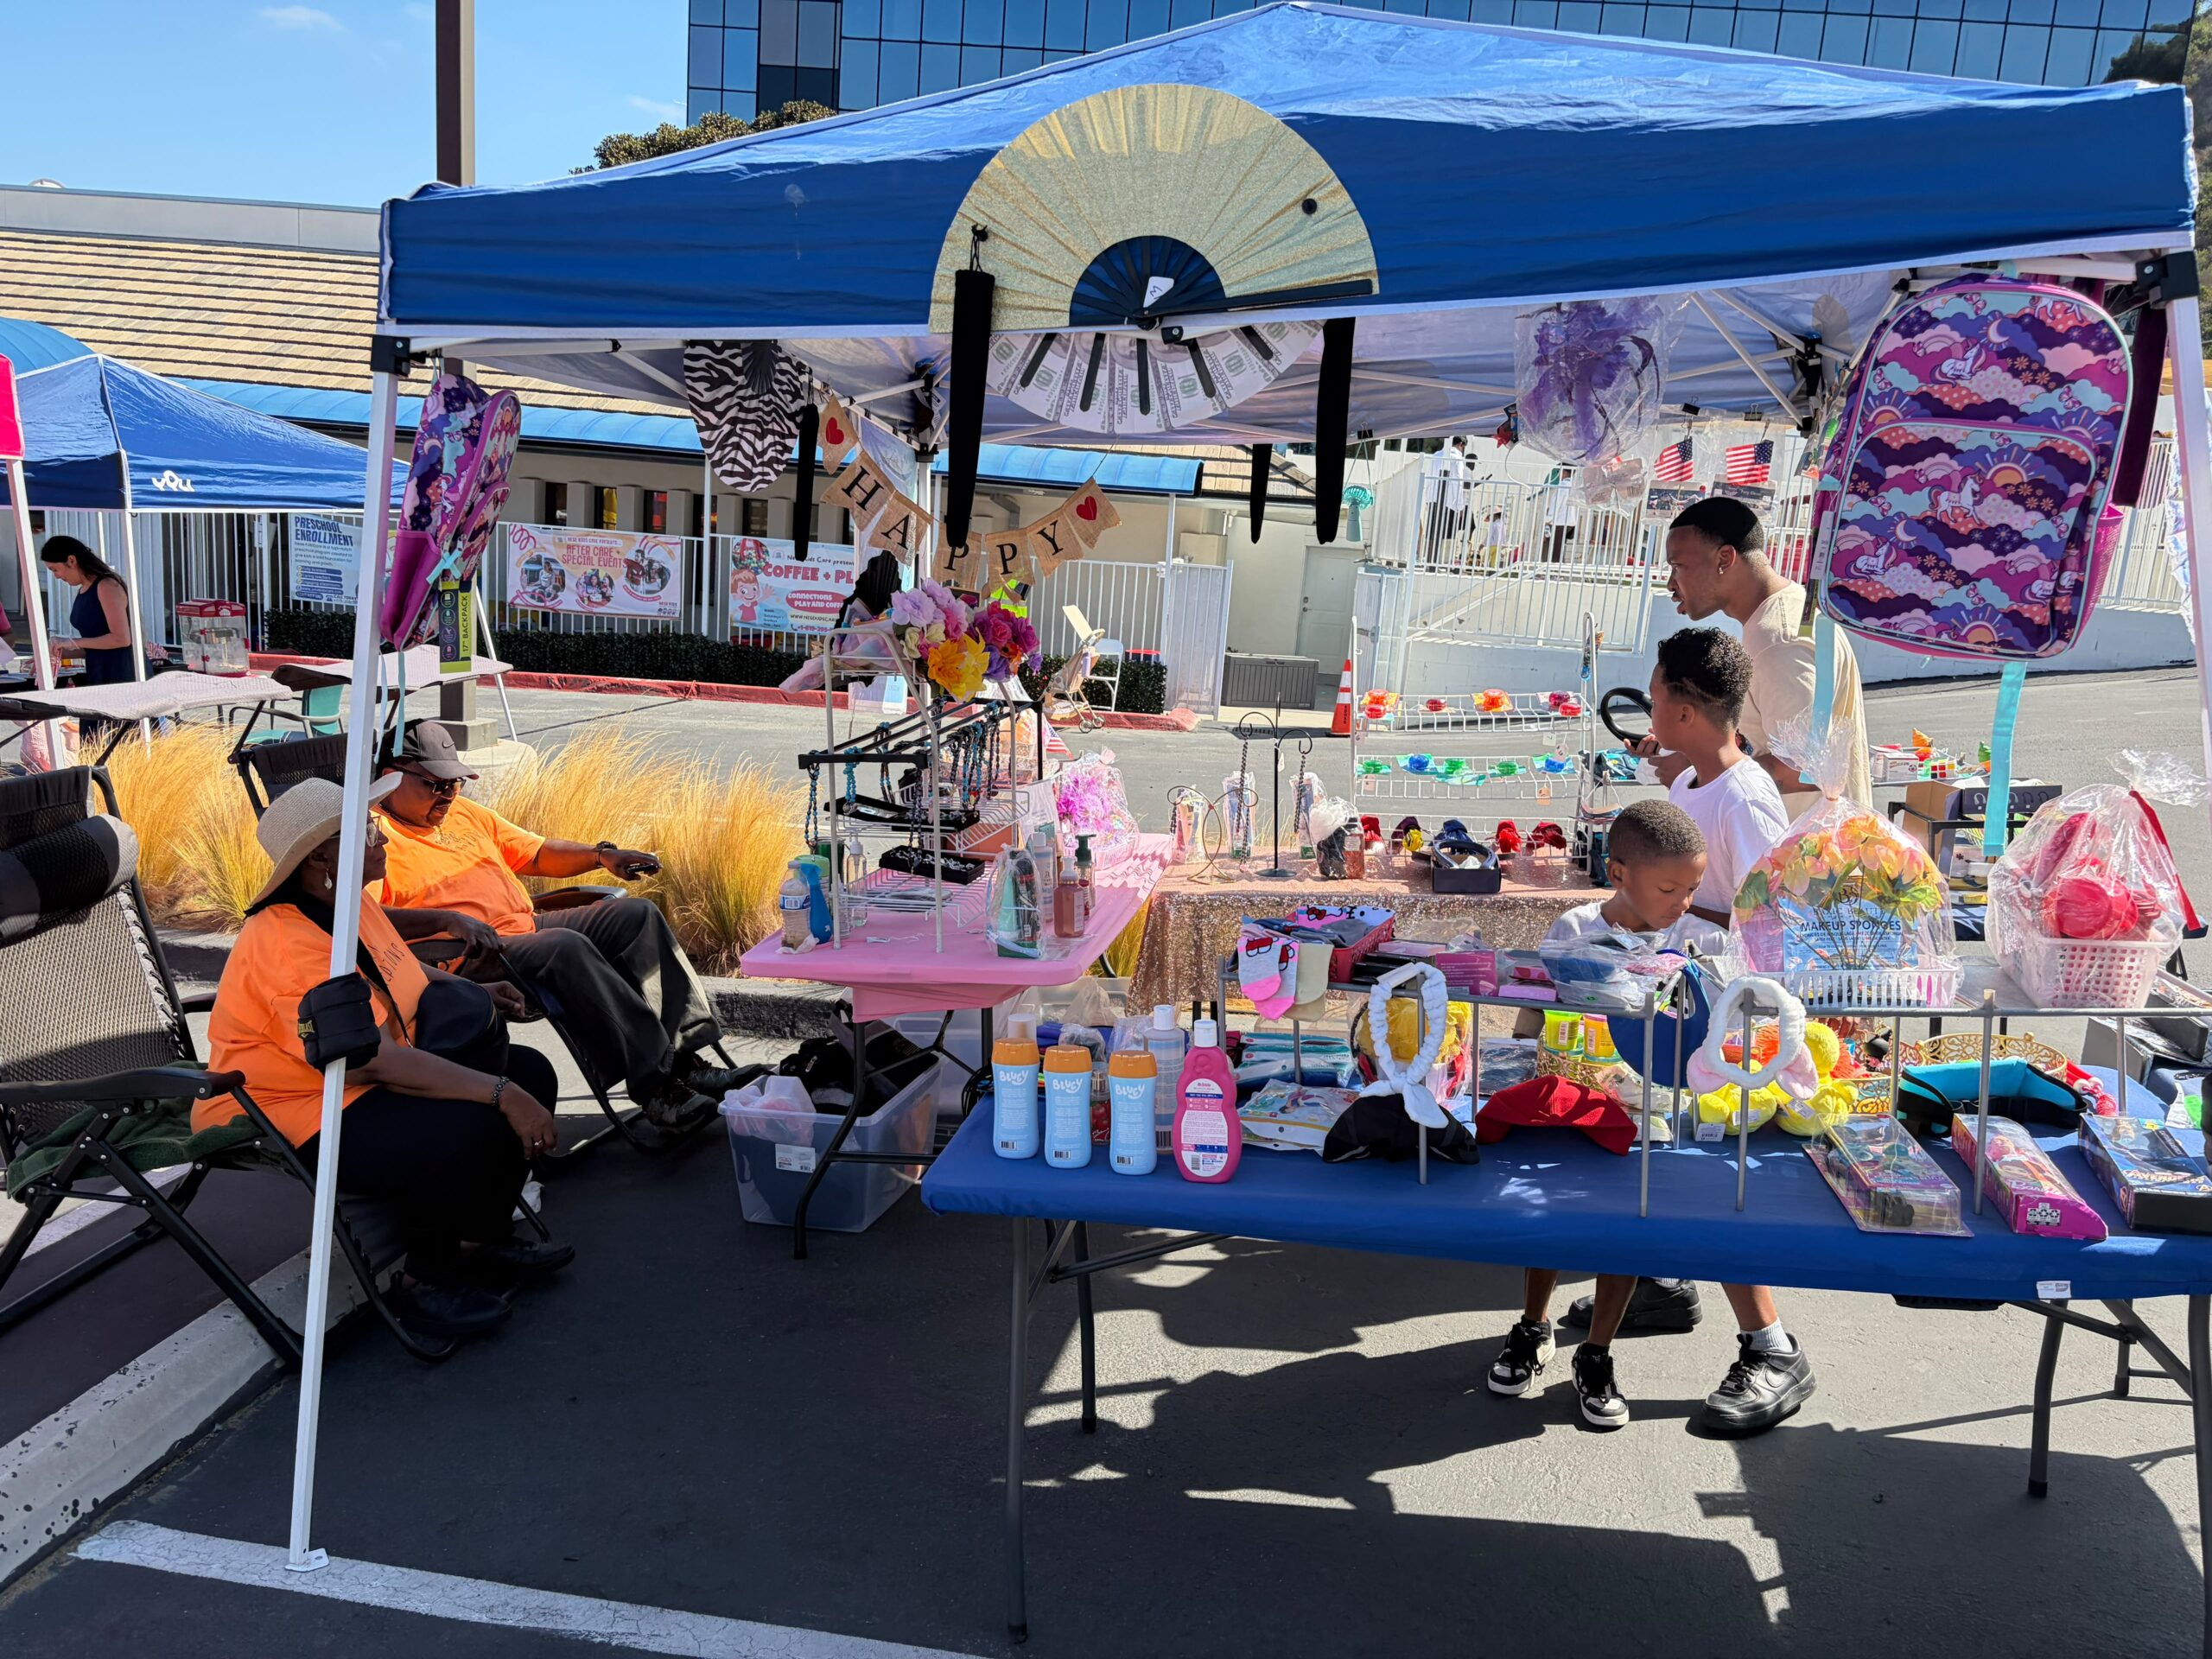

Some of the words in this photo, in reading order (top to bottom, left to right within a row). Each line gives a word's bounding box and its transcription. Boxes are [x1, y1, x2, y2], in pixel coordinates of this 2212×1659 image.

[295, 516, 342, 533] PRESCHOOL
[296, 529, 353, 546] ENROLLMENT
[566, 544, 590, 556] AFTER
[593, 546, 613, 557] CARE
[562, 554, 594, 566] SPECIAL
[763, 563, 819, 581] COFFEE
[1801, 920, 1846, 931] MAKEUP
[1849, 919, 1901, 931] SPONGES
[2010, 1179, 2064, 1197] Barbie
